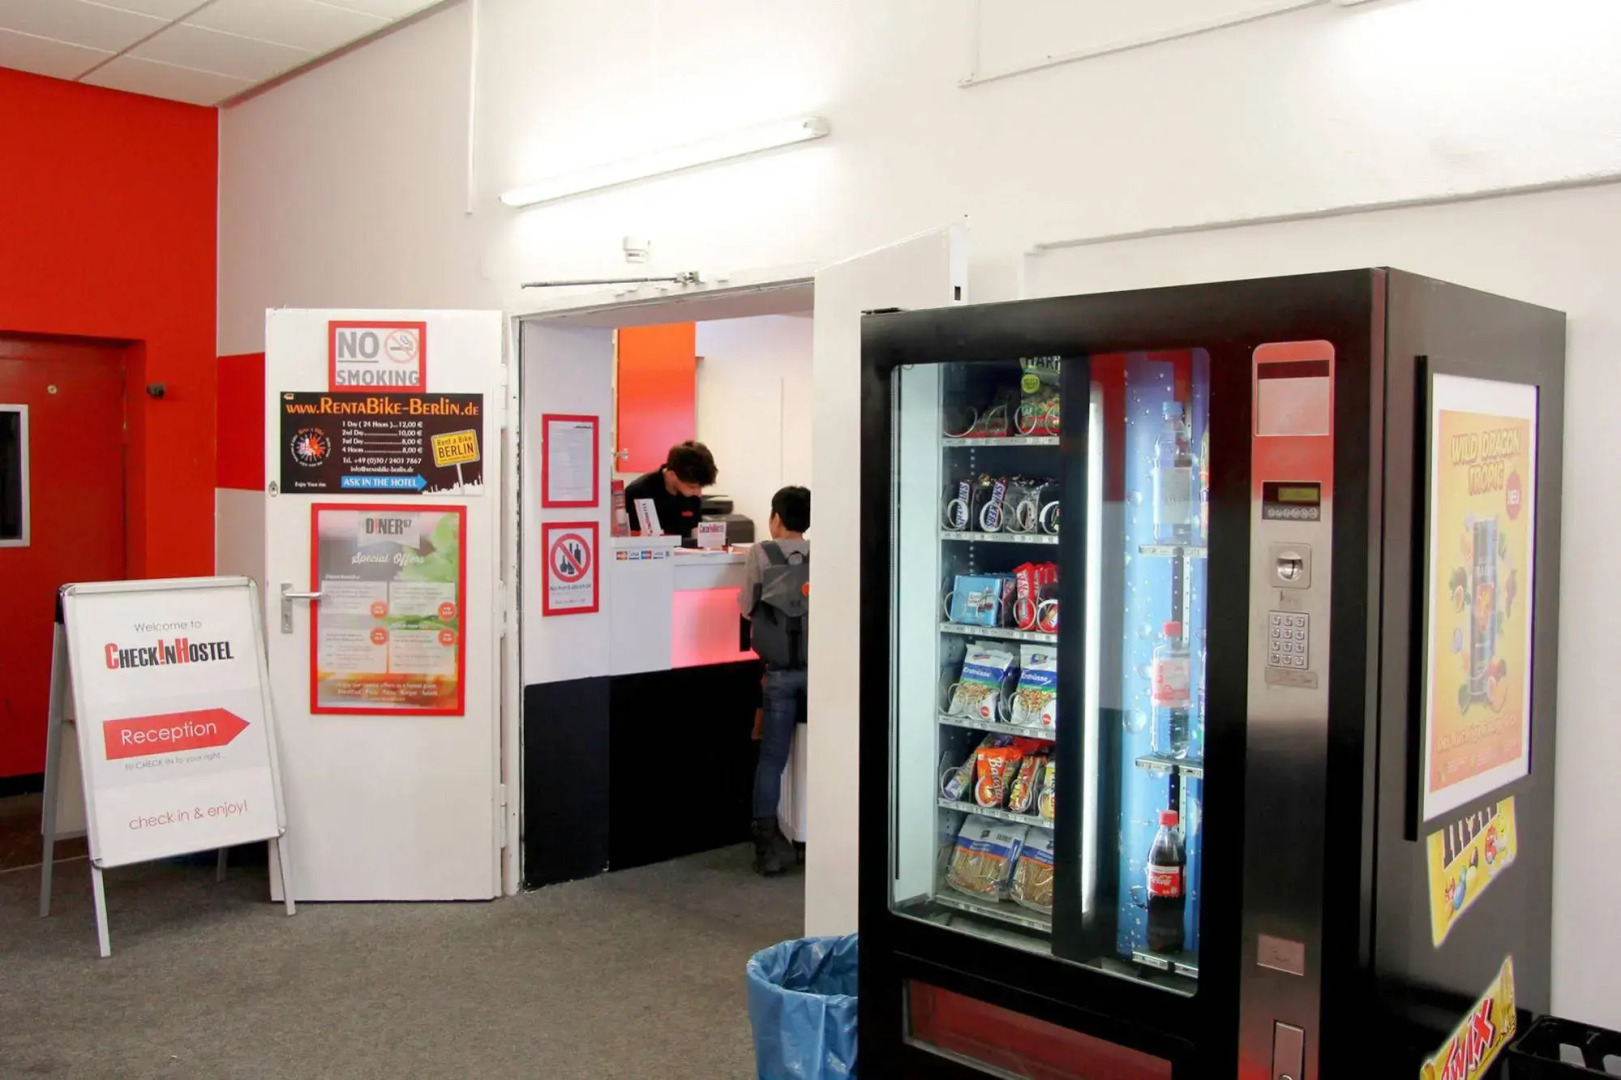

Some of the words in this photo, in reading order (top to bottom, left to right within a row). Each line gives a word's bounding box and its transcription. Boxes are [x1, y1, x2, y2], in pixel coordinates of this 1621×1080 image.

[338, 332, 380, 359] NO
[336, 370, 420, 386] SMOKING
[437, 438, 451, 446] Rent
[1451, 432, 1478, 466] WILD
[1481, 426, 1521, 462] DRAGON
[438, 442, 474, 459] BERLIN
[344, 478, 360, 486] ASK
[362, 478, 372, 486] IN
[373, 478, 387, 486] THE
[390, 478, 417, 486] HOTEL
[1468, 460, 1504, 496] TROPIC
[1508, 489, 1520, 505] NEU
[352, 552, 390, 566] Special
[393, 552, 424, 566] Offers
[134, 620, 188, 633] Welcome
[190, 620, 202, 630] to
[1021, 672, 1049, 682] Erdnüsse
[121, 720, 217, 745] Reception
[129, 812, 174, 830] check
[177, 809, 189, 821] in
[194, 807, 204, 819] &
[208, 800, 248, 817] enjoy!
